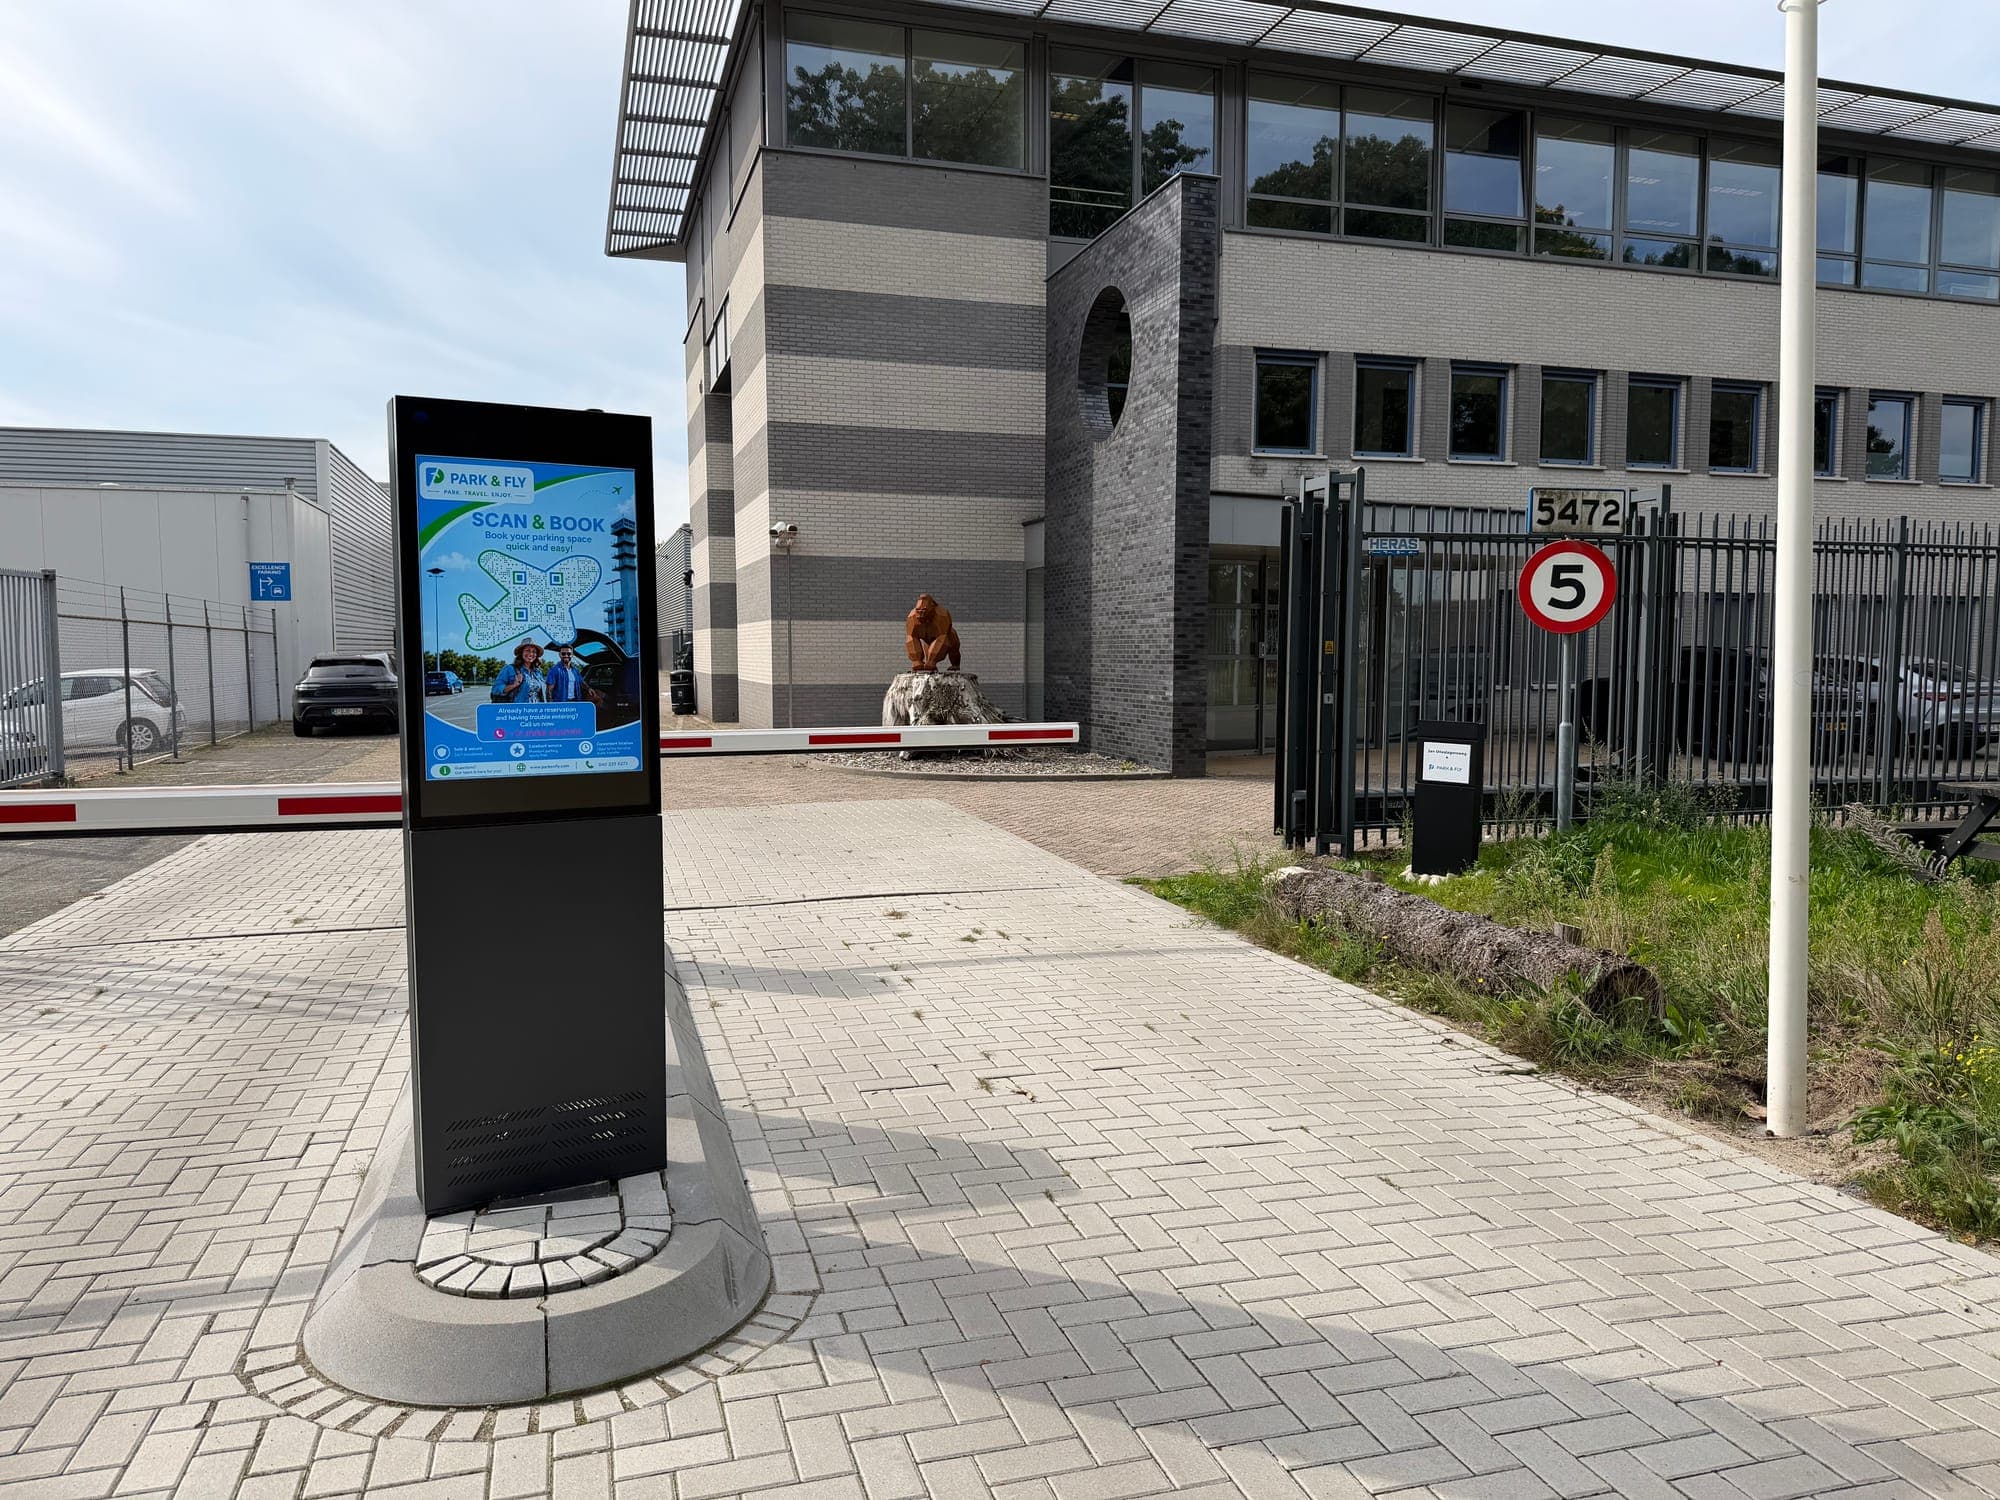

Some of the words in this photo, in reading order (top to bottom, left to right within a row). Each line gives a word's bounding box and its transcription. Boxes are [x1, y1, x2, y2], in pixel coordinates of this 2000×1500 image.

[450, 472, 488, 486] PARK
[491, 475, 501, 487] &
[504, 476, 527, 488] FLY
[1536, 498, 1620, 526] 5472
[471, 512, 528, 529] SCAN
[532, 514, 545, 530] &
[550, 516, 606, 533] BOOK
[485, 531, 508, 540] Book
[509, 534, 530, 542] your
[532, 534, 565, 544] parking
[567, 536, 592, 545] space
[1369, 538, 1418, 549] HERAS
[505, 543, 530, 553] quick
[531, 543, 549, 552] and
[550, 545, 573, 553] easy!
[1547, 564, 1586, 610] 5
